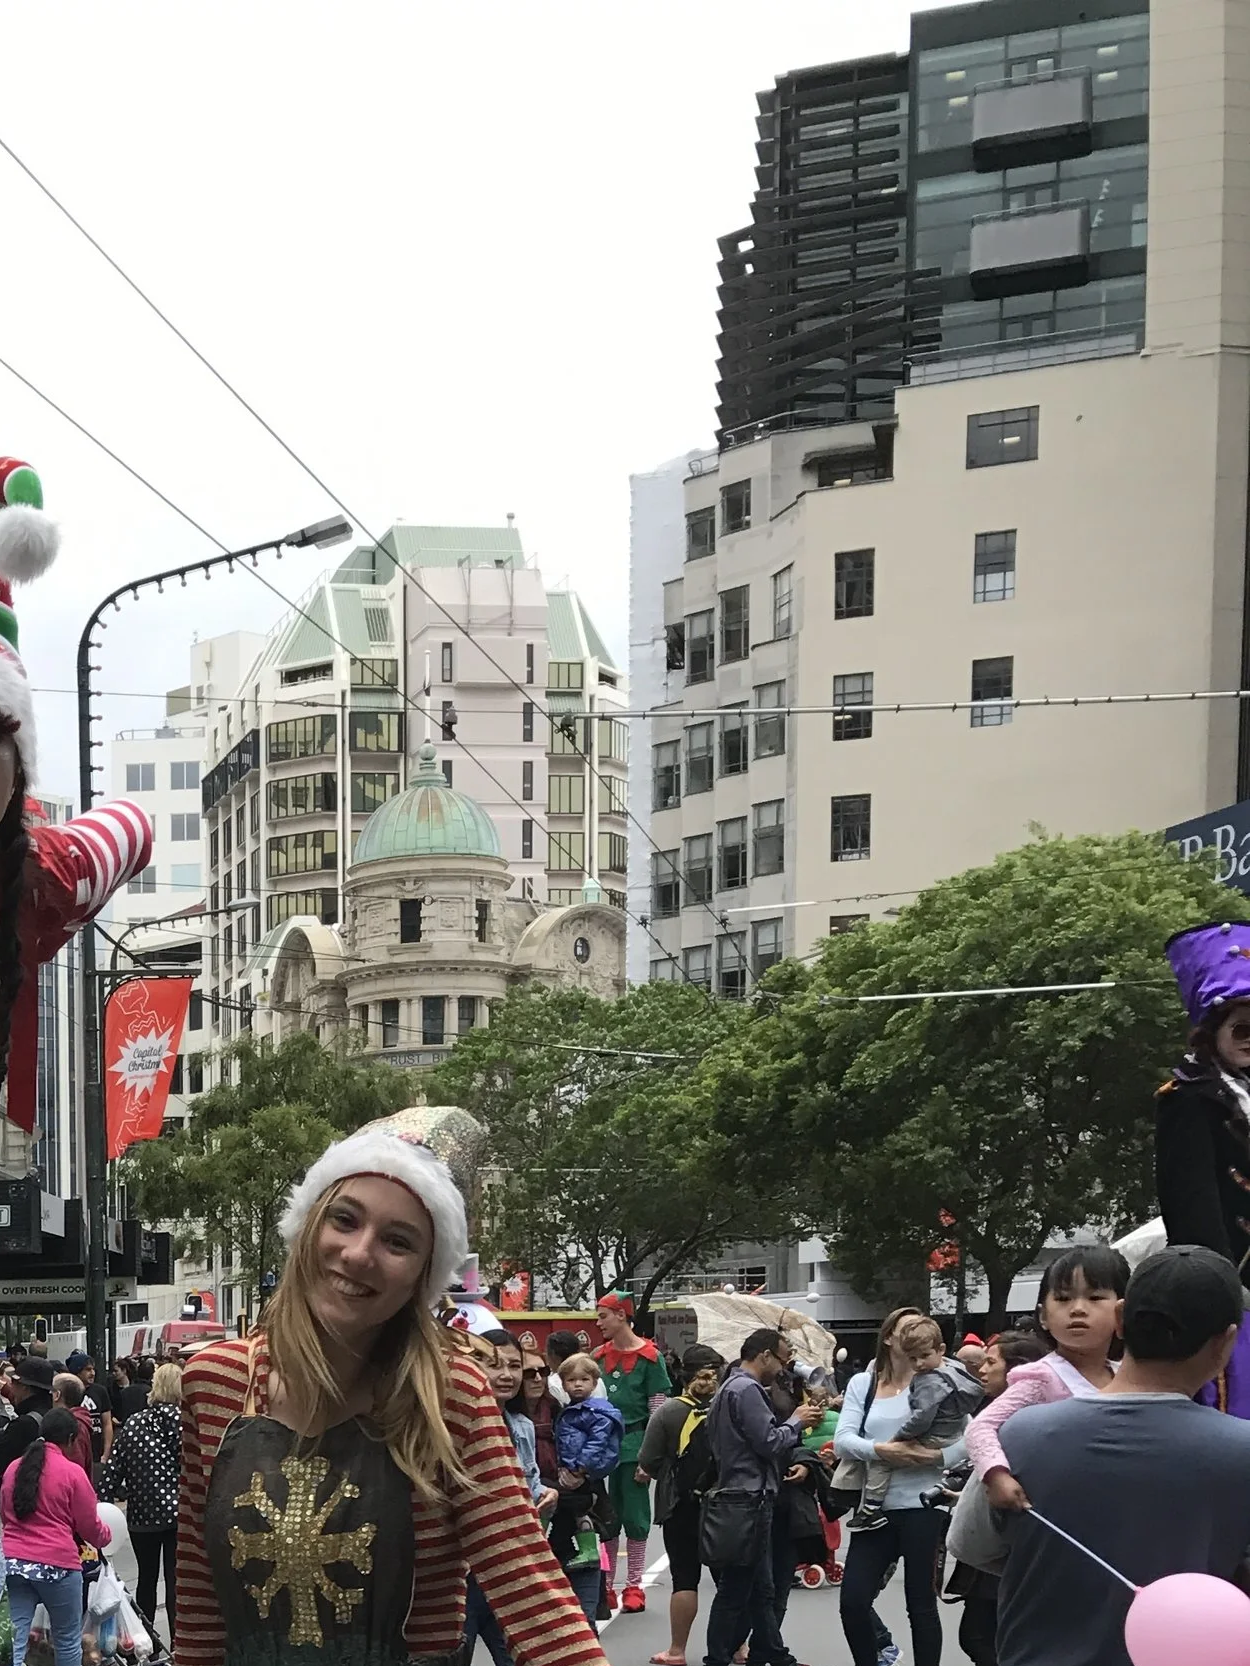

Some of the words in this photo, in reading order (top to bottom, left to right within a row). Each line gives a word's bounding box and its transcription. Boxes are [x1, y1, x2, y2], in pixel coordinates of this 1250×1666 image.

[133, 1045, 162, 1061] Capital
[2, 1286, 28, 1295] OVEN
[29, 1285, 60, 1294] FRESH
